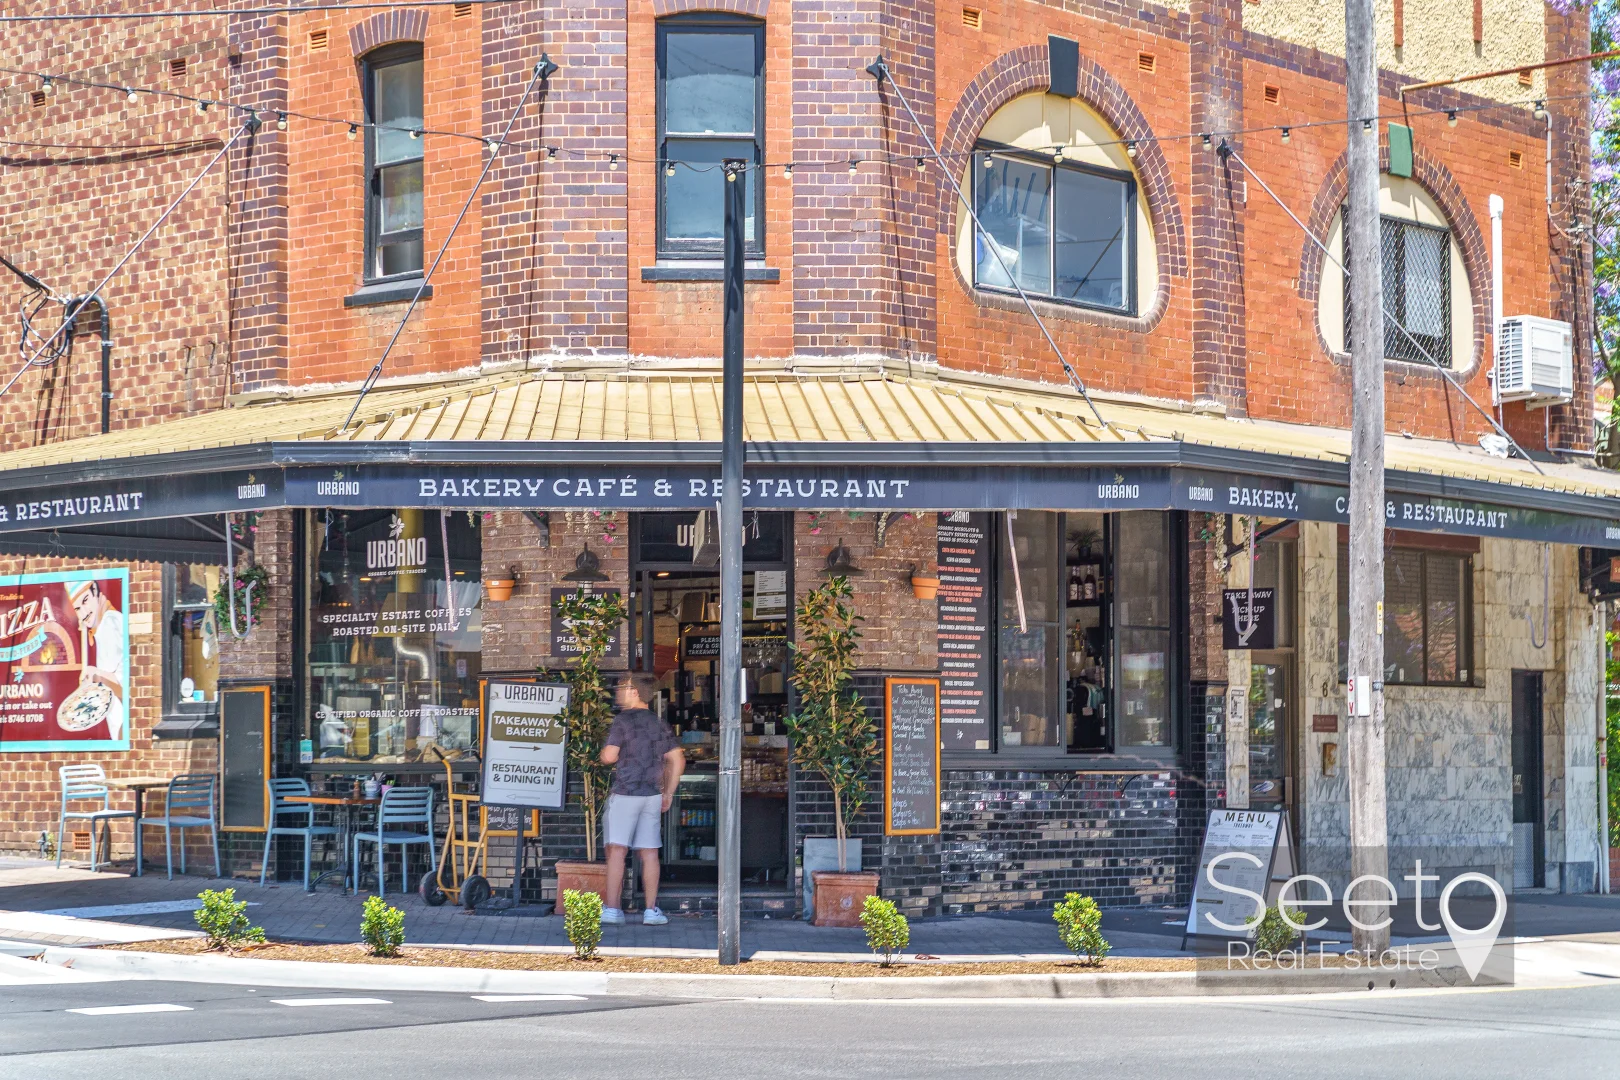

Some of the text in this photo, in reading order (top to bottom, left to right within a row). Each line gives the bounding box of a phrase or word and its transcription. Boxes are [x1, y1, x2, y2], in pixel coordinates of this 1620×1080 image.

[237, 484, 266, 499] URBANO
[317, 481, 359, 495] URBANO
[418, 475, 909, 498] BAKERY CAFÉ & RESTAURANT
[1098, 484, 1140, 499] URBANO
[1189, 486, 1214, 501] URBANO
[16, 492, 143, 521] RESTAURANT
[1229, 486, 1508, 529] BAKERY, & RESTAURANT
[366, 537, 427, 569] URBANO
[1225, 590, 1272, 600] TAKE WAY
[0, 596, 57, 640] IZZA
[322, 607, 472, 624] SPECIALTY ESTATE COFFES
[332, 626, 379, 637] ROASTED
[383, 624, 426, 634] ON-SITE
[585, 644, 612, 652] DR
[0, 684, 44, 699] URBANO
[504, 685, 554, 702] URBANO
[21, 700, 39, 710] take
[39, 701, 53, 709] out
[26, 713, 44, 722] 0708
[315, 707, 480, 719] CETIFIED ORGANIC COFFEE ROASTERS
[493, 715, 551, 728] TAKEAWAY
[505, 727, 550, 738] BAKERY
[491, 763, 558, 776] RESTAURANT
[493, 773, 555, 785] & DINING IN
[1224, 811, 1266, 823] MENU
